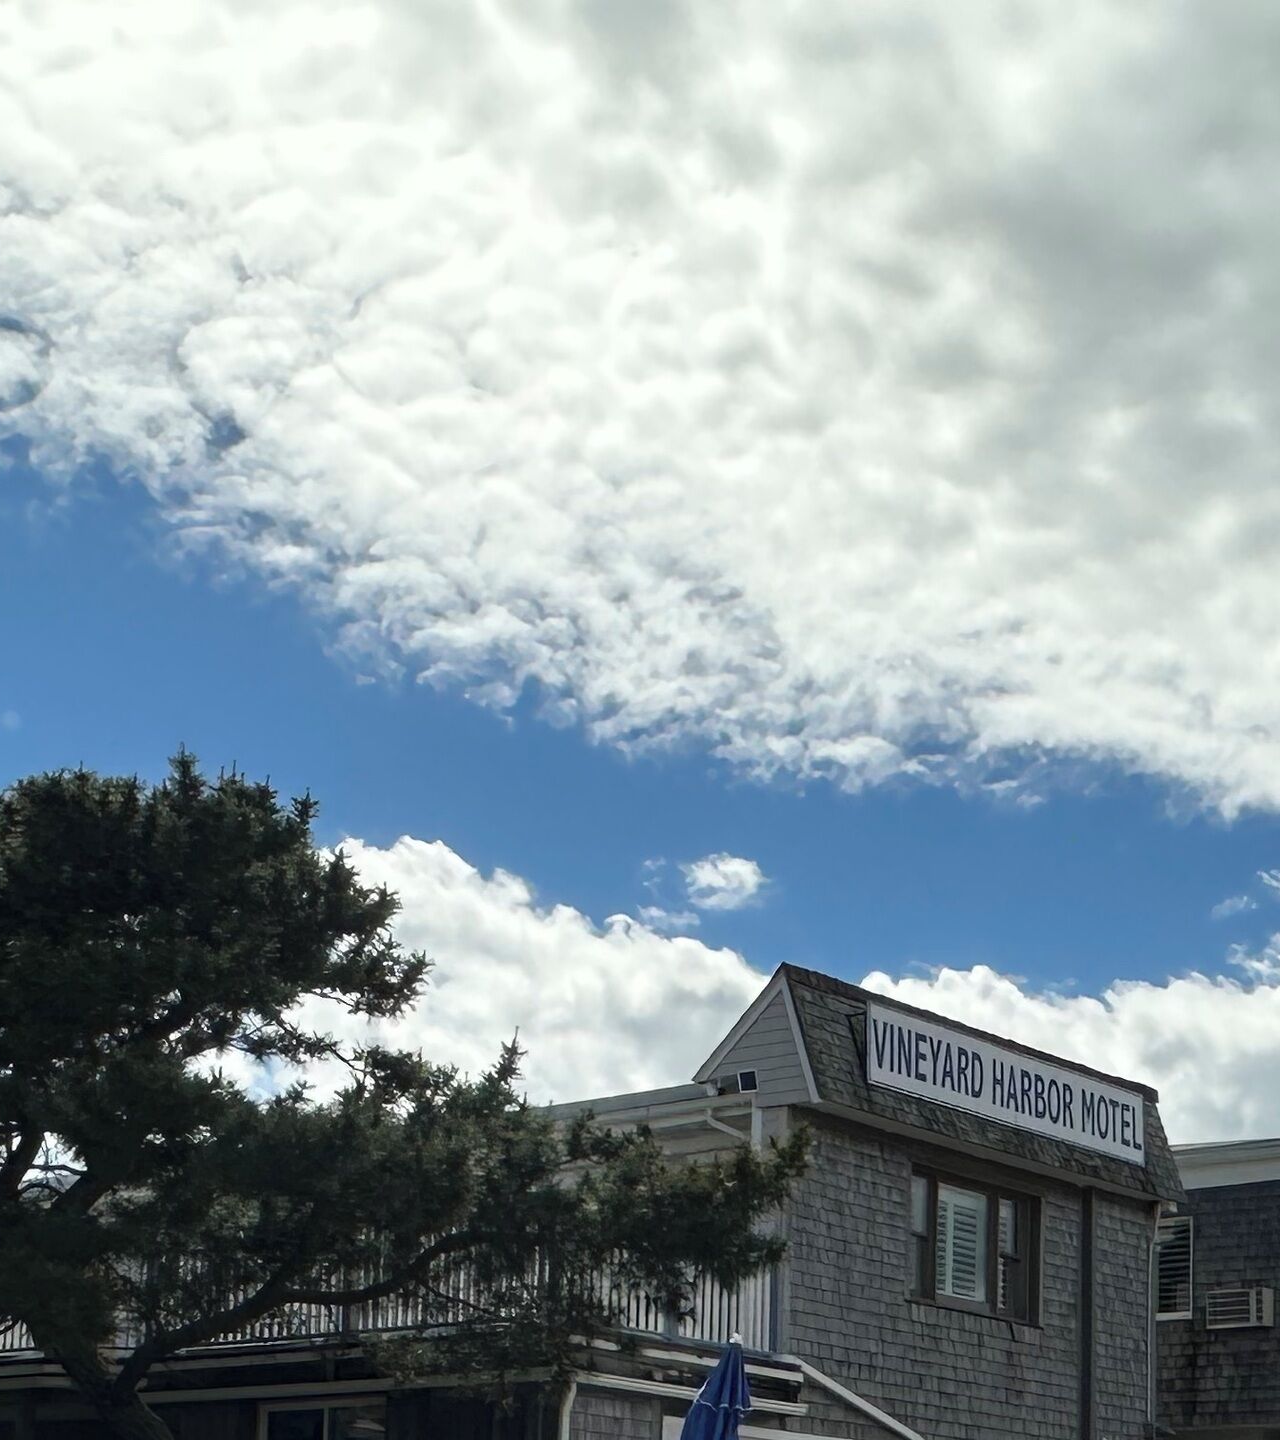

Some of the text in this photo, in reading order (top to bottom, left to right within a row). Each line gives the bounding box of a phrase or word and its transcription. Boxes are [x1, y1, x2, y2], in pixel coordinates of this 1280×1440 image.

[872, 1018, 1142, 1150] VINEYARD HARBOR MOTEL
